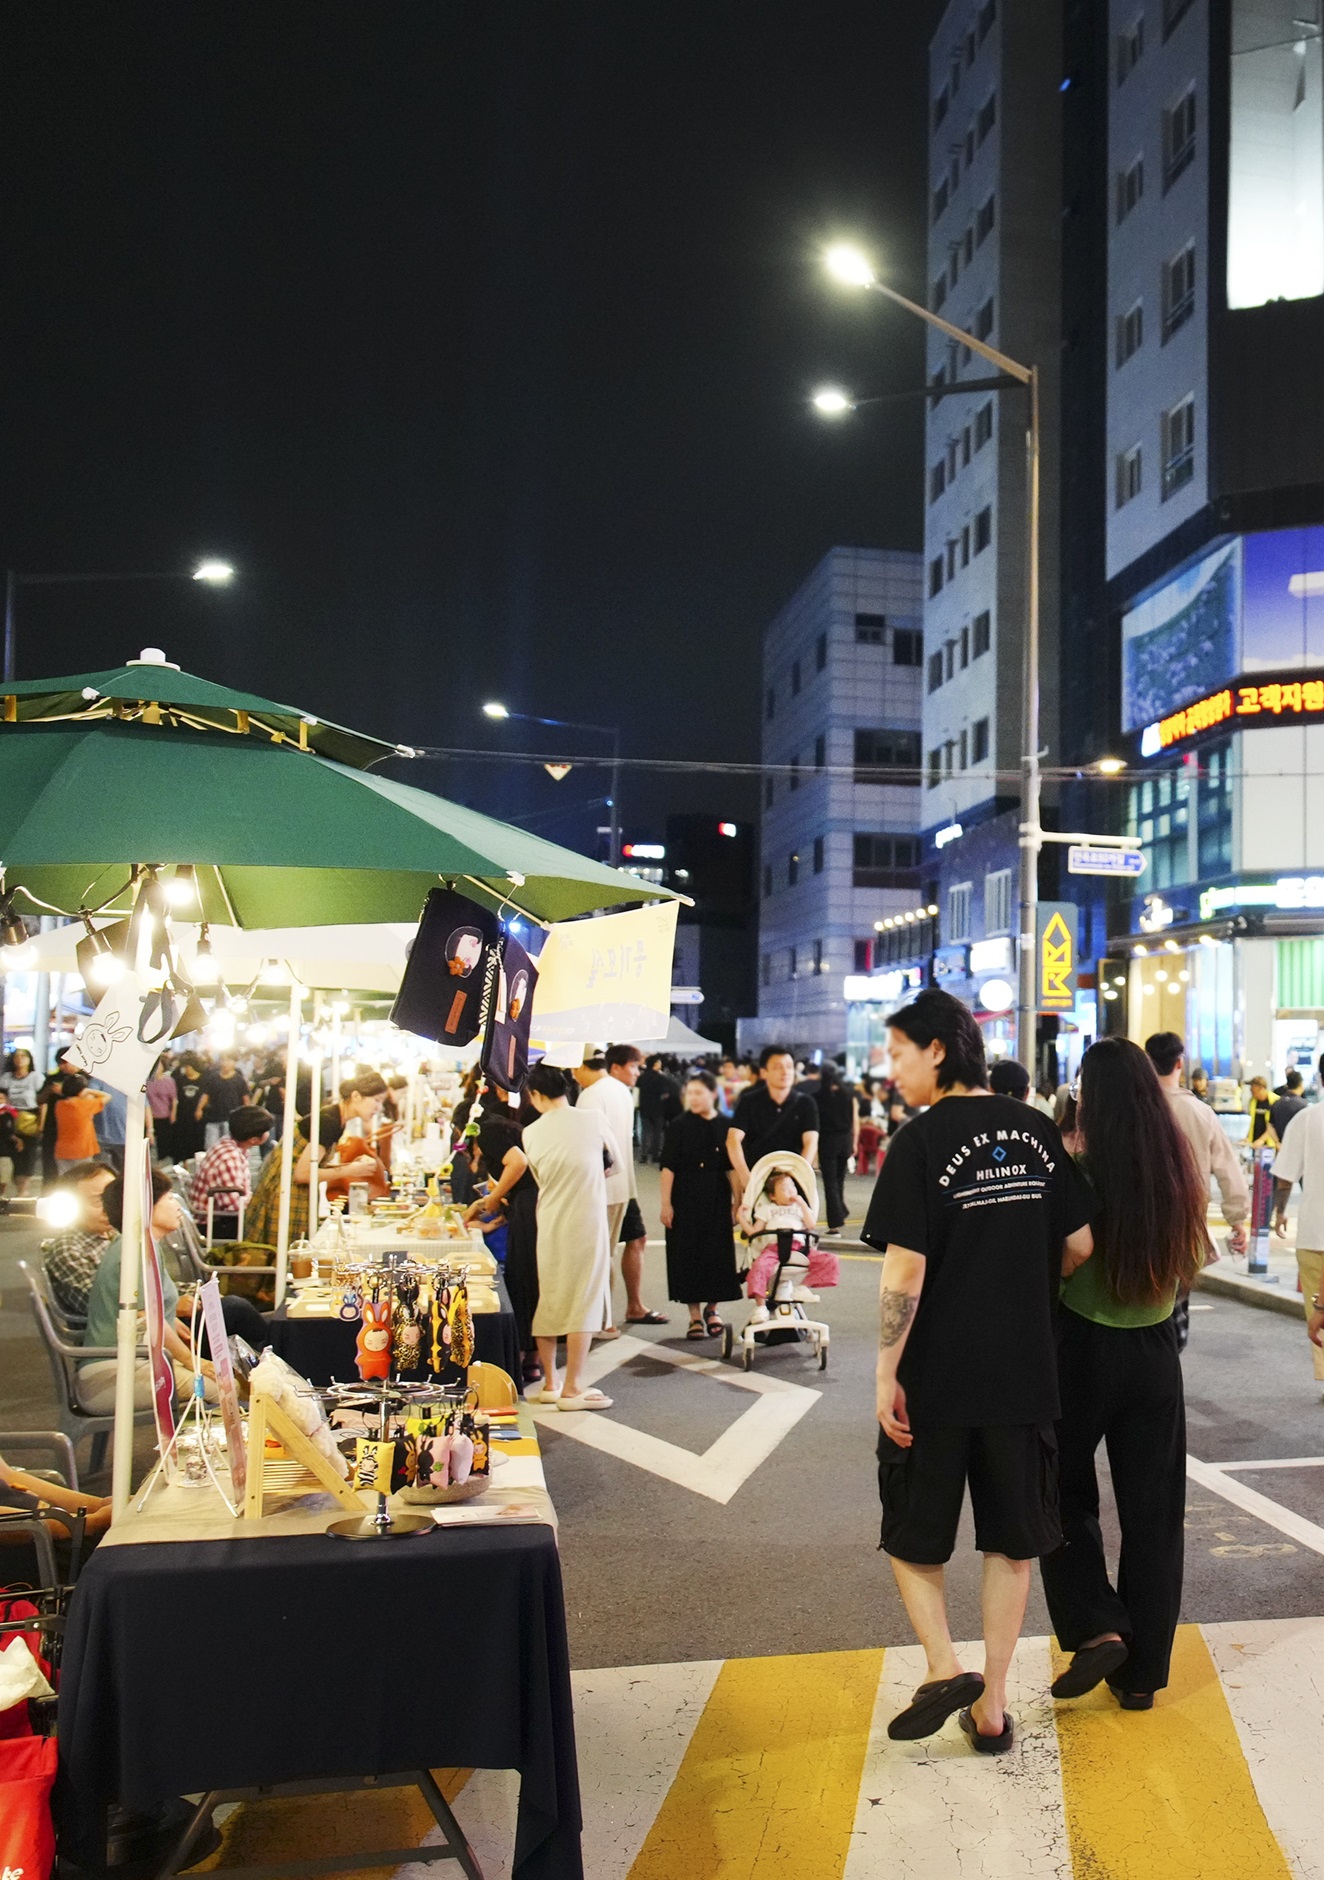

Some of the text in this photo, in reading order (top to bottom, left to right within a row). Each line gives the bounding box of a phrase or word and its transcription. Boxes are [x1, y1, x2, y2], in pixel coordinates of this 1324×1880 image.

[938, 1129, 1057, 1188] DEUS EX MACHINA
[976, 1163, 1027, 1182] HELINOX
